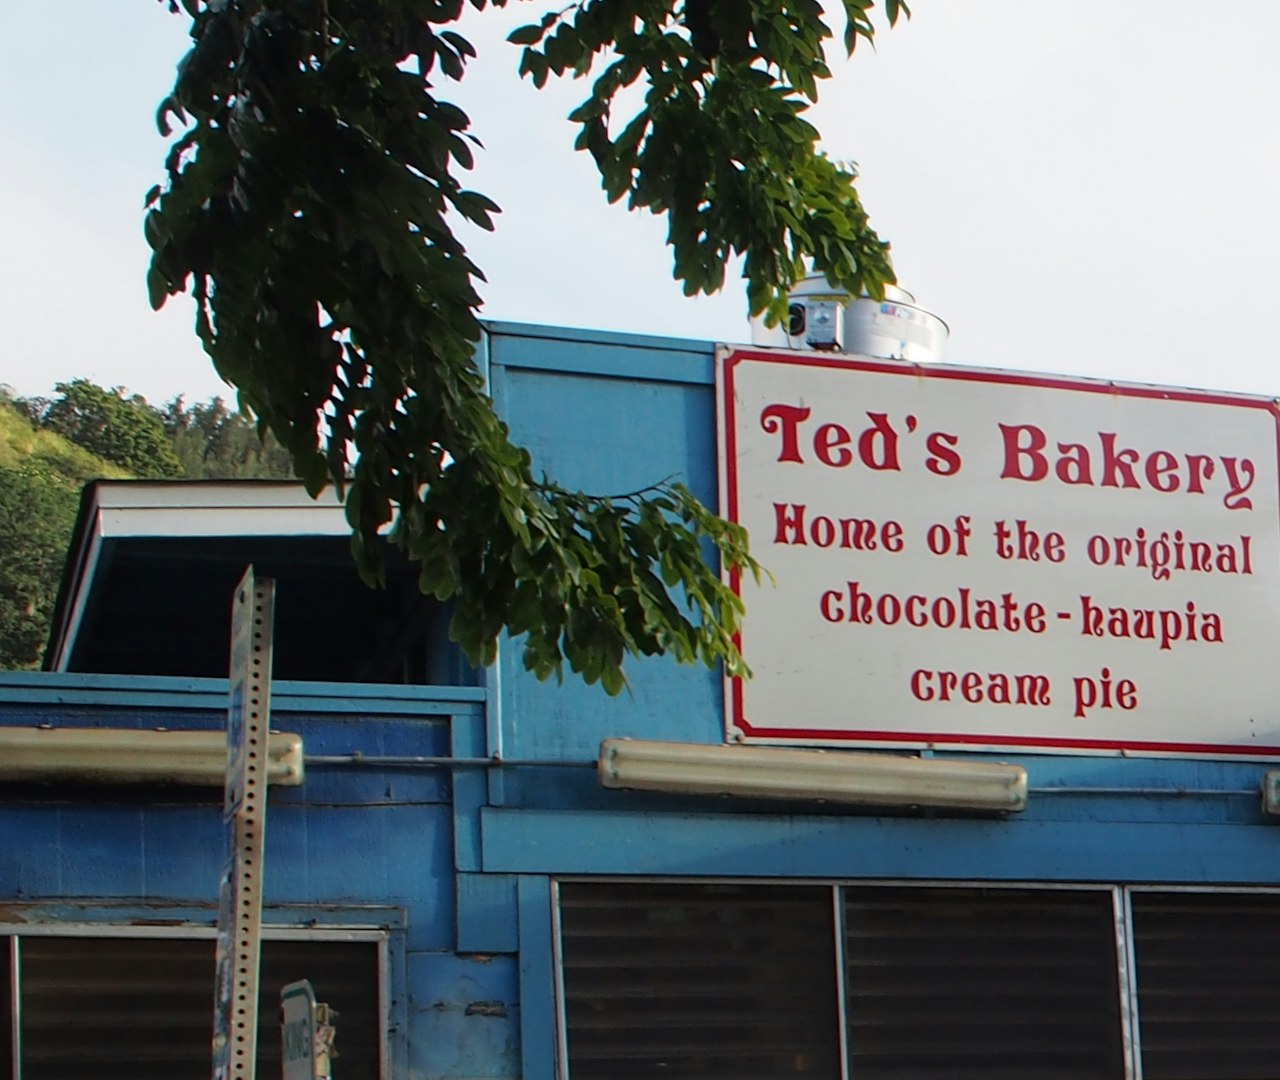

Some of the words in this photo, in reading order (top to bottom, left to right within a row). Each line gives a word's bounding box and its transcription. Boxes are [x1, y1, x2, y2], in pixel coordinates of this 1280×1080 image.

[760, 403, 962, 476] Ted's
[998, 422, 1255, 511] Bakery
[773, 502, 904, 553] Home
[927, 515, 971, 557] of
[994, 520, 1066, 563] the
[1088, 528, 1253, 580] original
[820, 582, 1224, 650] chocolate-haupia
[911, 667, 1051, 707] cream
[1074, 668, 1138, 718] pie
